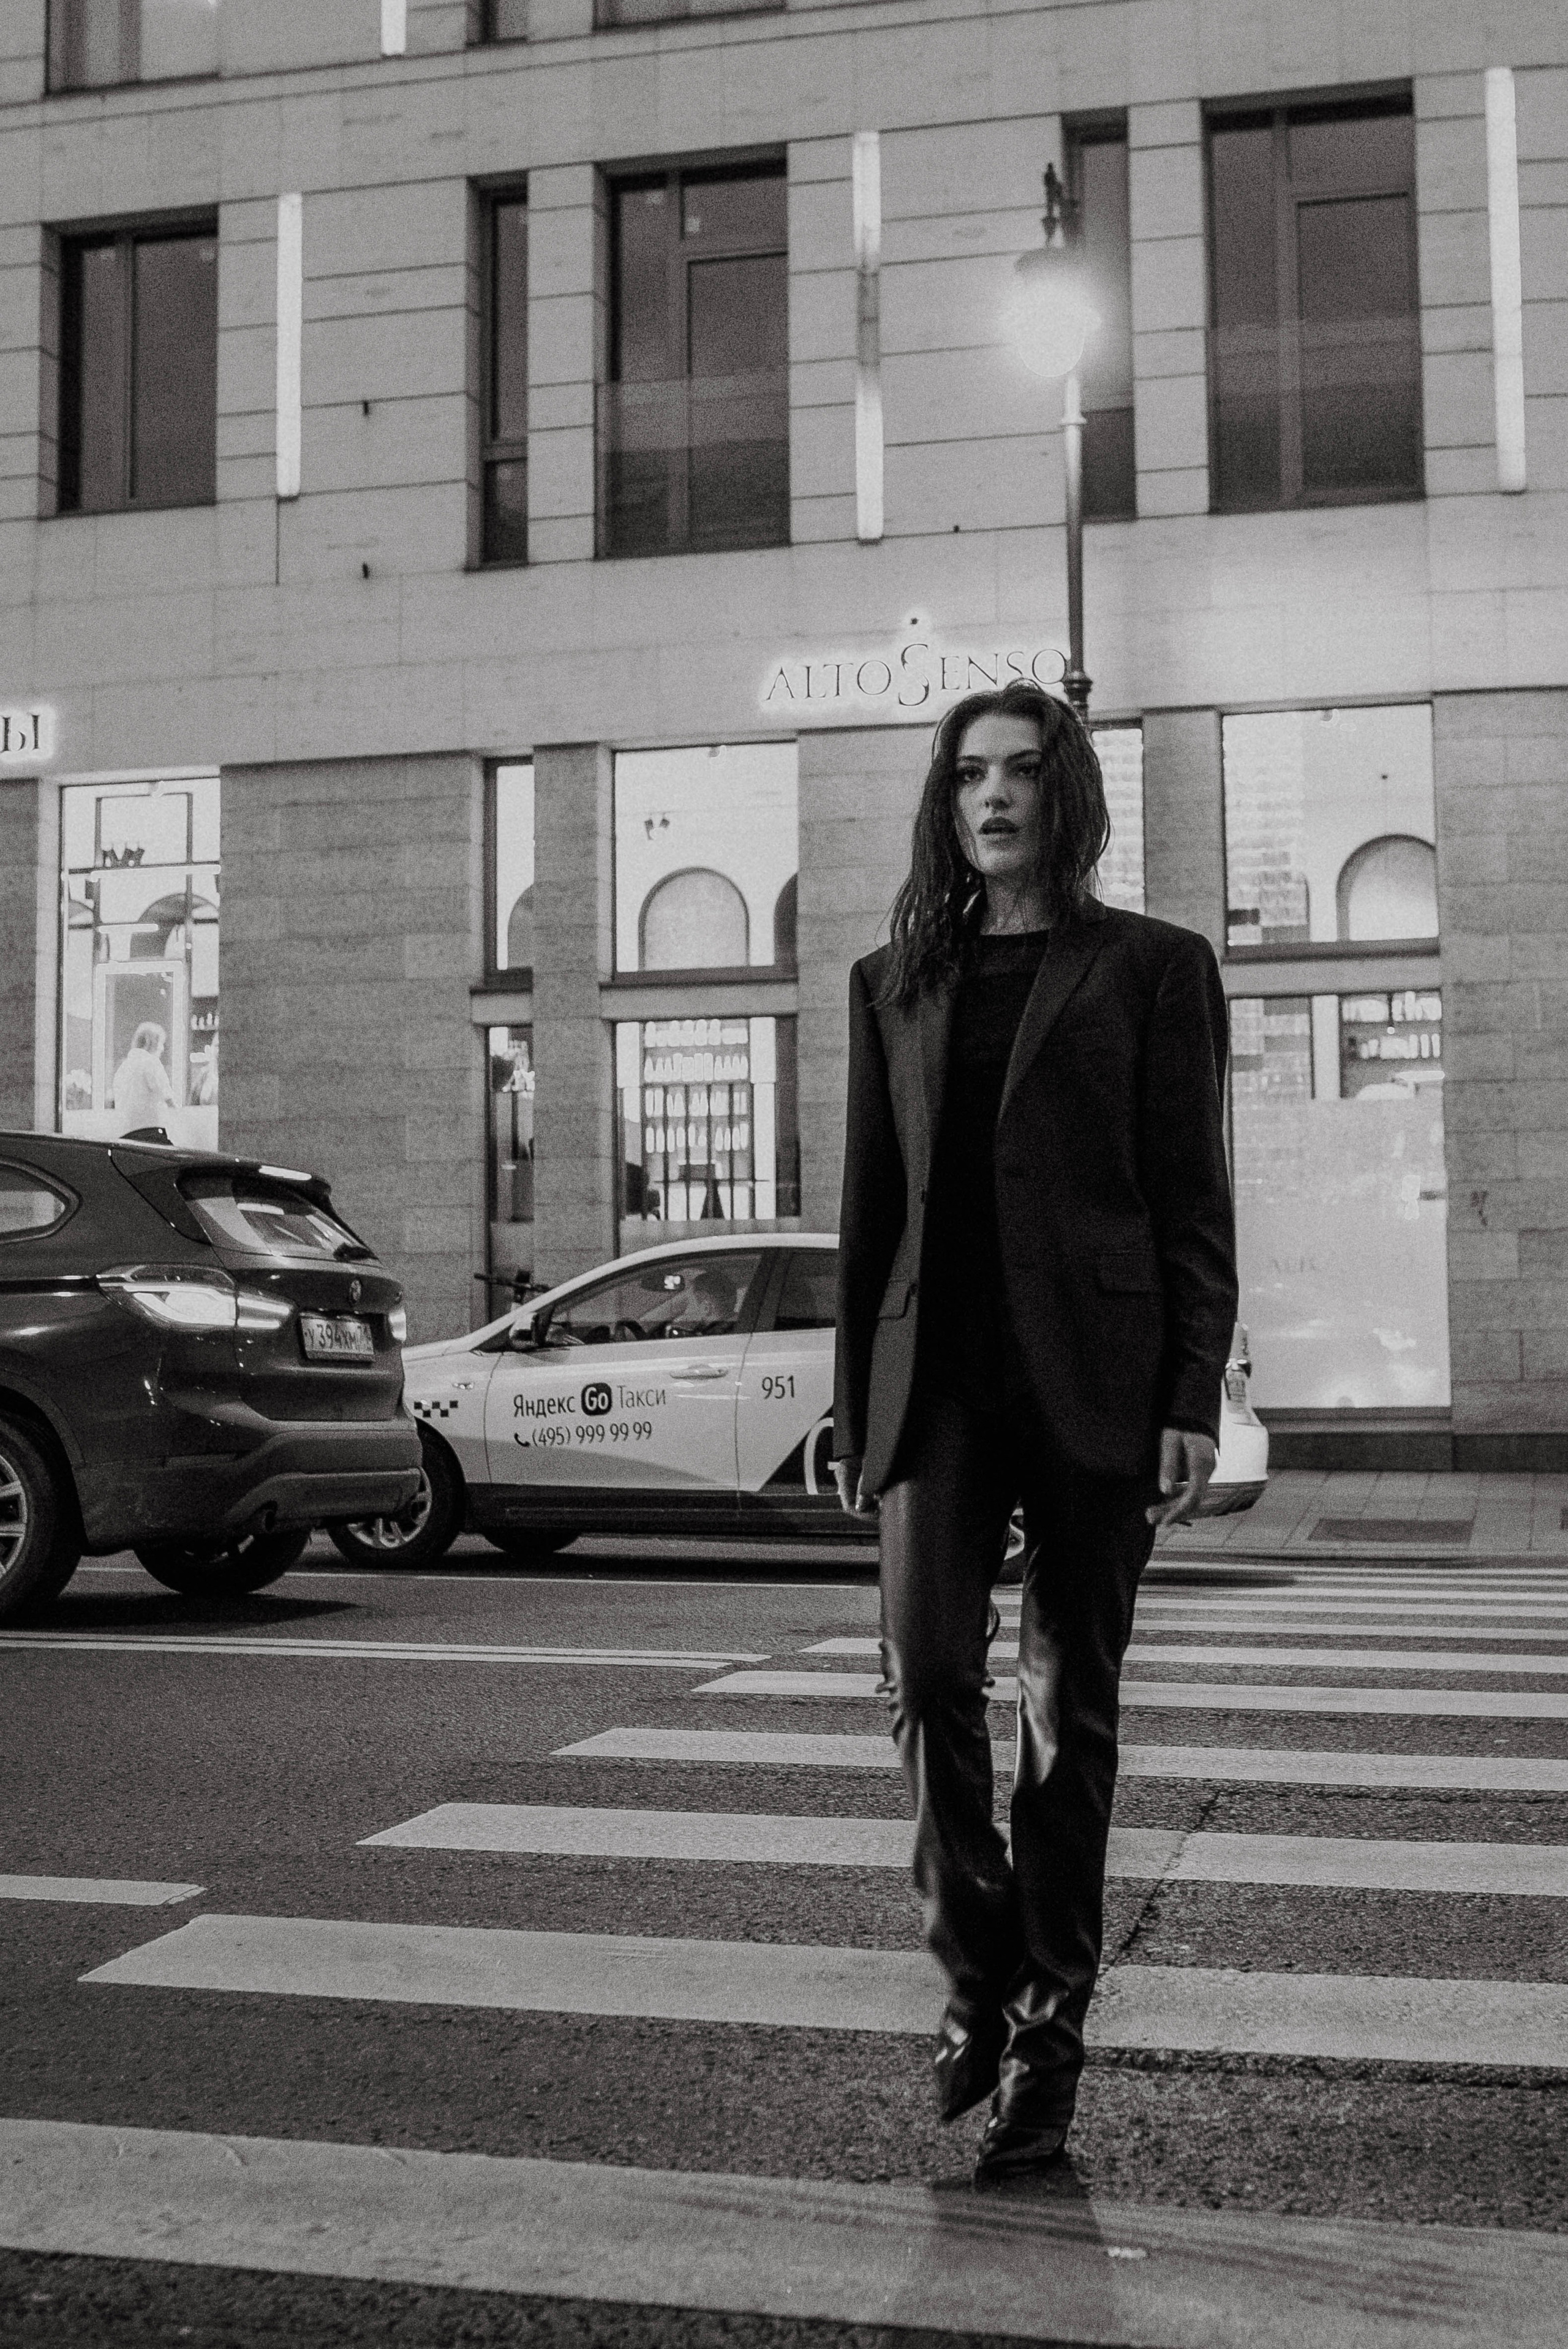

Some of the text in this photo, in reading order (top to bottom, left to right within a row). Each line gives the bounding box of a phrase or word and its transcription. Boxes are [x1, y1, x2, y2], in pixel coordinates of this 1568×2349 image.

[761, 1375, 796, 1399] 951
[513, 1384, 666, 1418] Яндекс Go Такси
[532, 1421, 652, 1448] (495) 999 99 99
